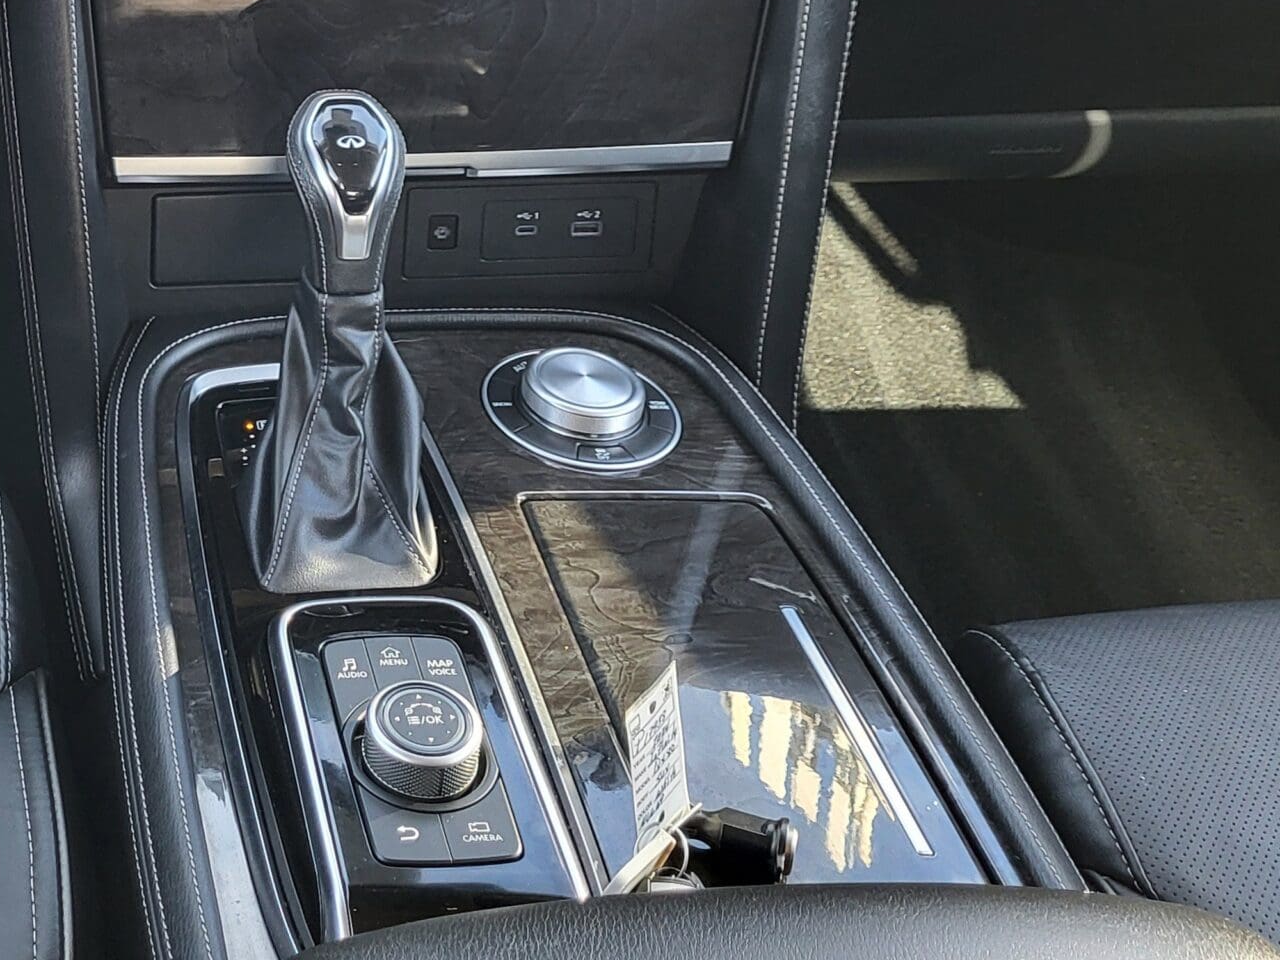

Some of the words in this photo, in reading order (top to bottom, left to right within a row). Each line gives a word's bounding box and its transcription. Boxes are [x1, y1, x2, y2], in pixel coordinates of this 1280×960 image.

[426, 660, 454, 668] MAP
[337, 671, 368, 679] AUDIO
[428, 668, 458, 676] VOICE
[462, 834, 504, 842] CAMERA
